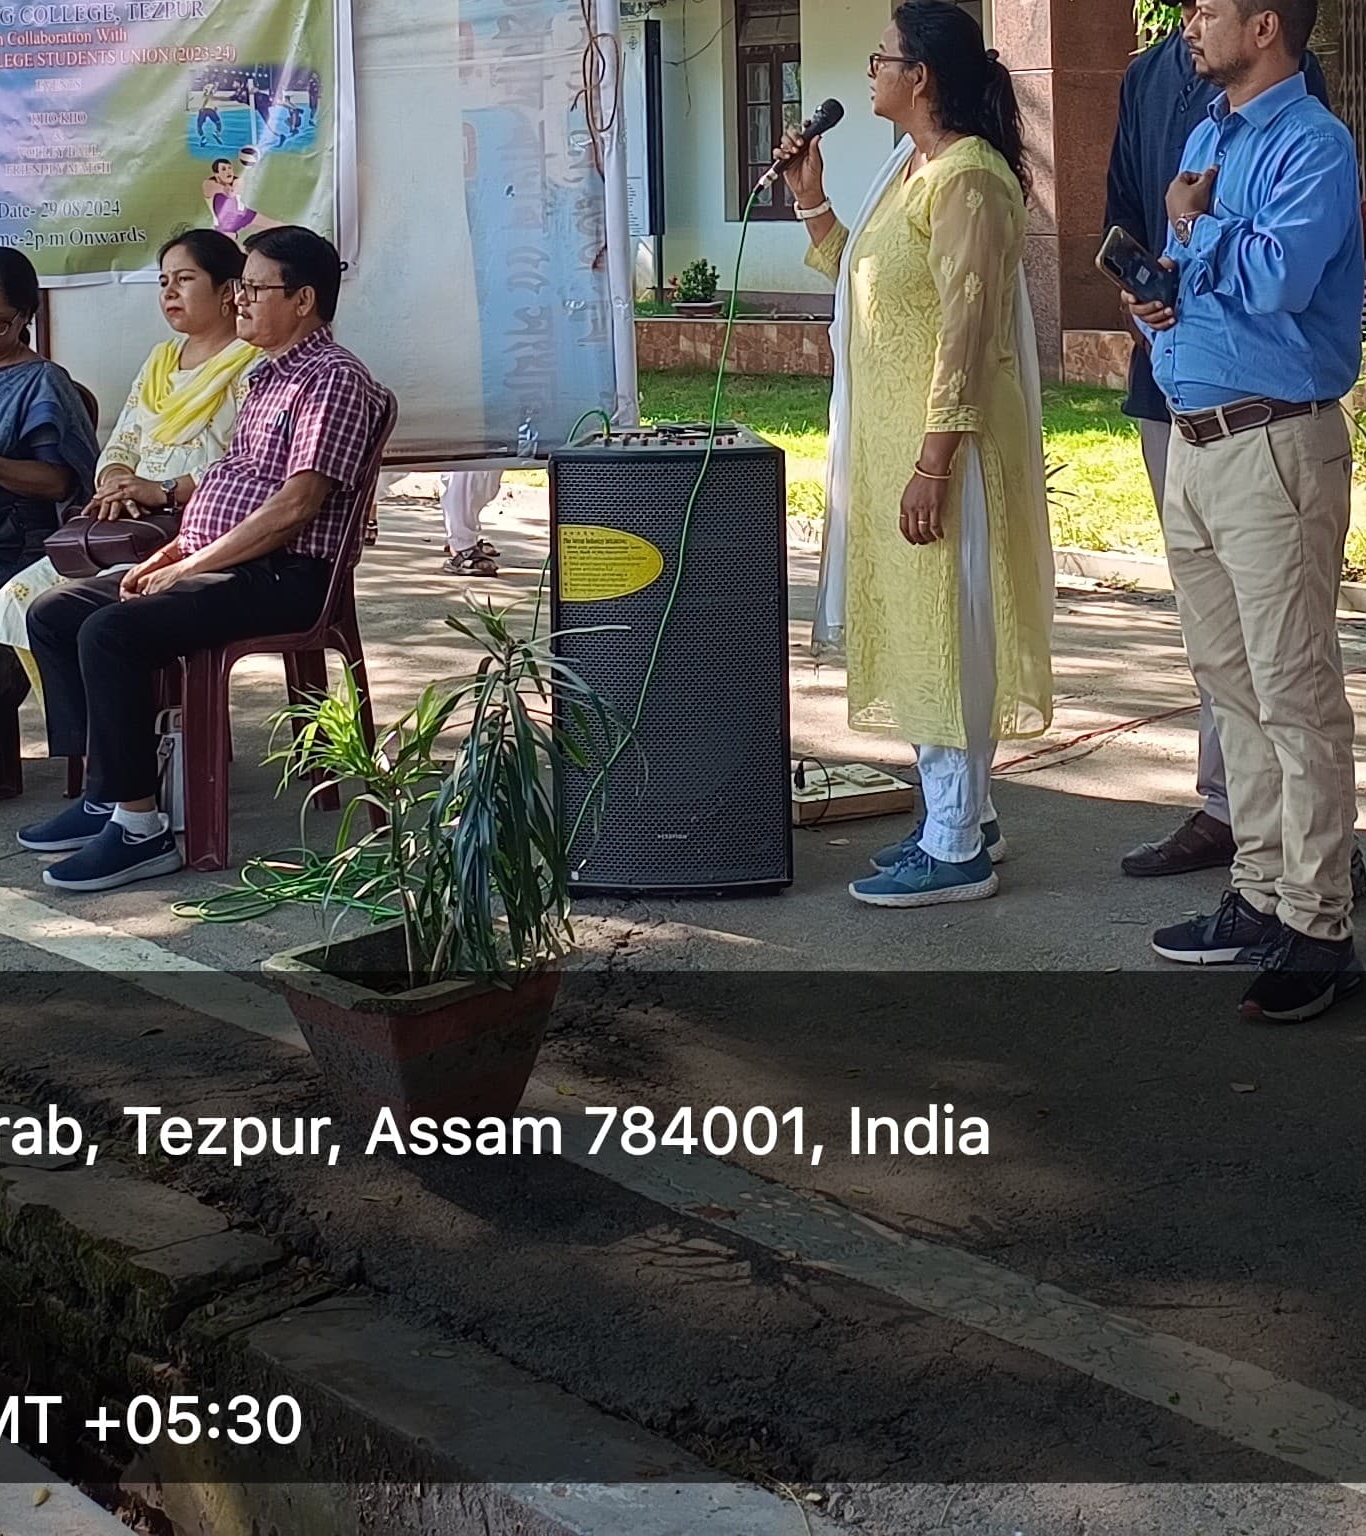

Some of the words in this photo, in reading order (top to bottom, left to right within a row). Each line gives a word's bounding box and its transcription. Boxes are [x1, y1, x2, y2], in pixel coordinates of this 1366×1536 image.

[19, 3, 120, 26] COLLEGE,
[127, 0, 205, 21] TEZPUR
[7, 29, 92, 46] Collaboration
[96, 27, 128, 44] With
[37, 49, 120, 66] STUDENTS
[121, 47, 169, 64] UNION
[173, 46, 237, 65] (2023-24)
[69, 227, 147, 246] Onwards
